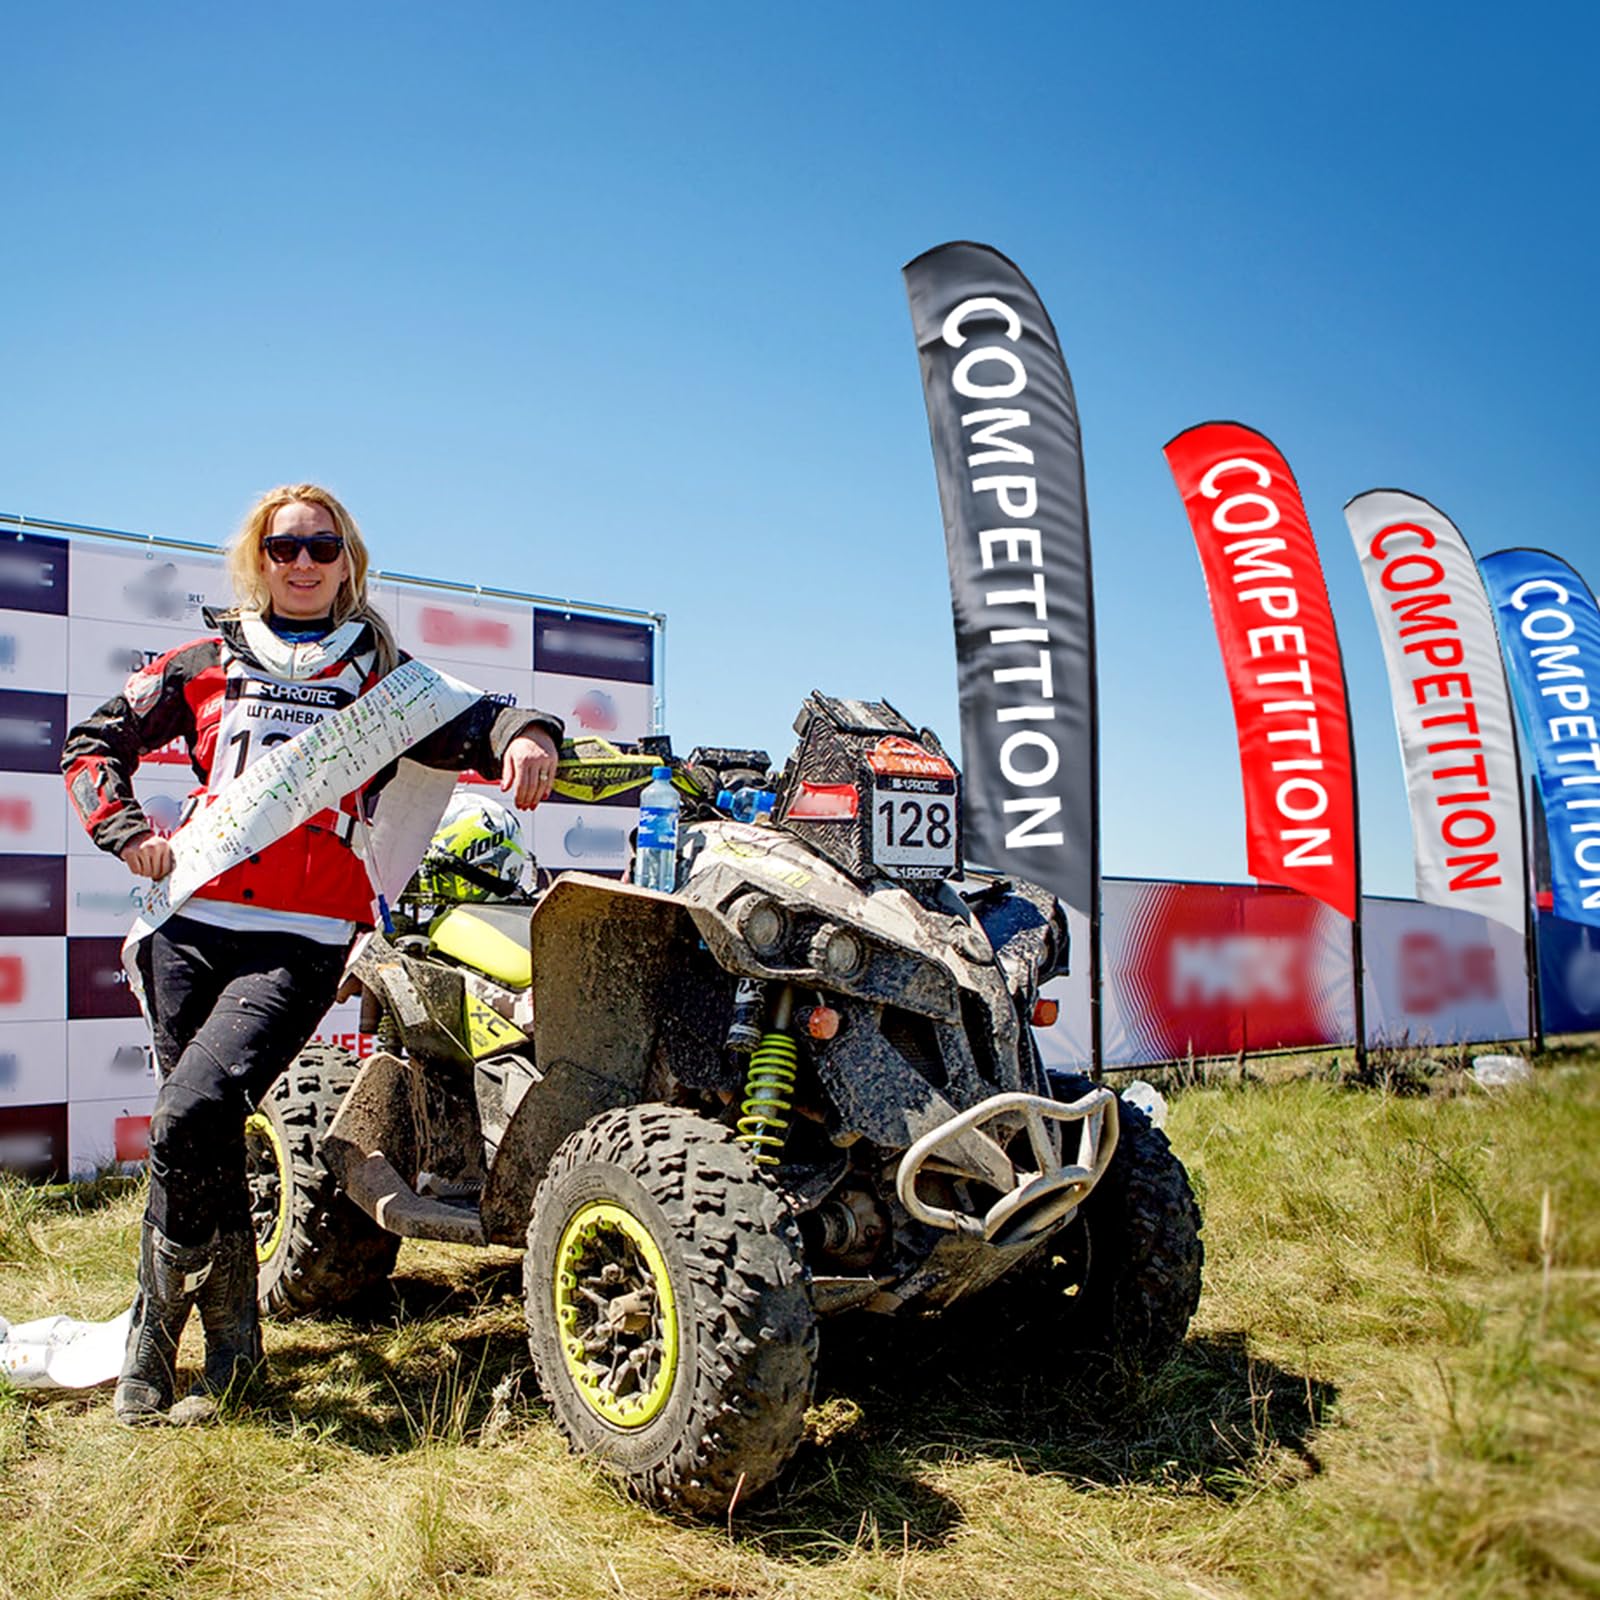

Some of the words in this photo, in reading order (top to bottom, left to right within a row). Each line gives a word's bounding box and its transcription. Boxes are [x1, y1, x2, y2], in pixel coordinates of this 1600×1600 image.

[246, 704, 325, 726] ШТАНЕВА
[940, 296, 1064, 850] COMPETITION
[1199, 457, 1333, 868] COMPETITION
[1369, 519, 1503, 893] COMPETITION
[878, 800, 952, 850] 128
